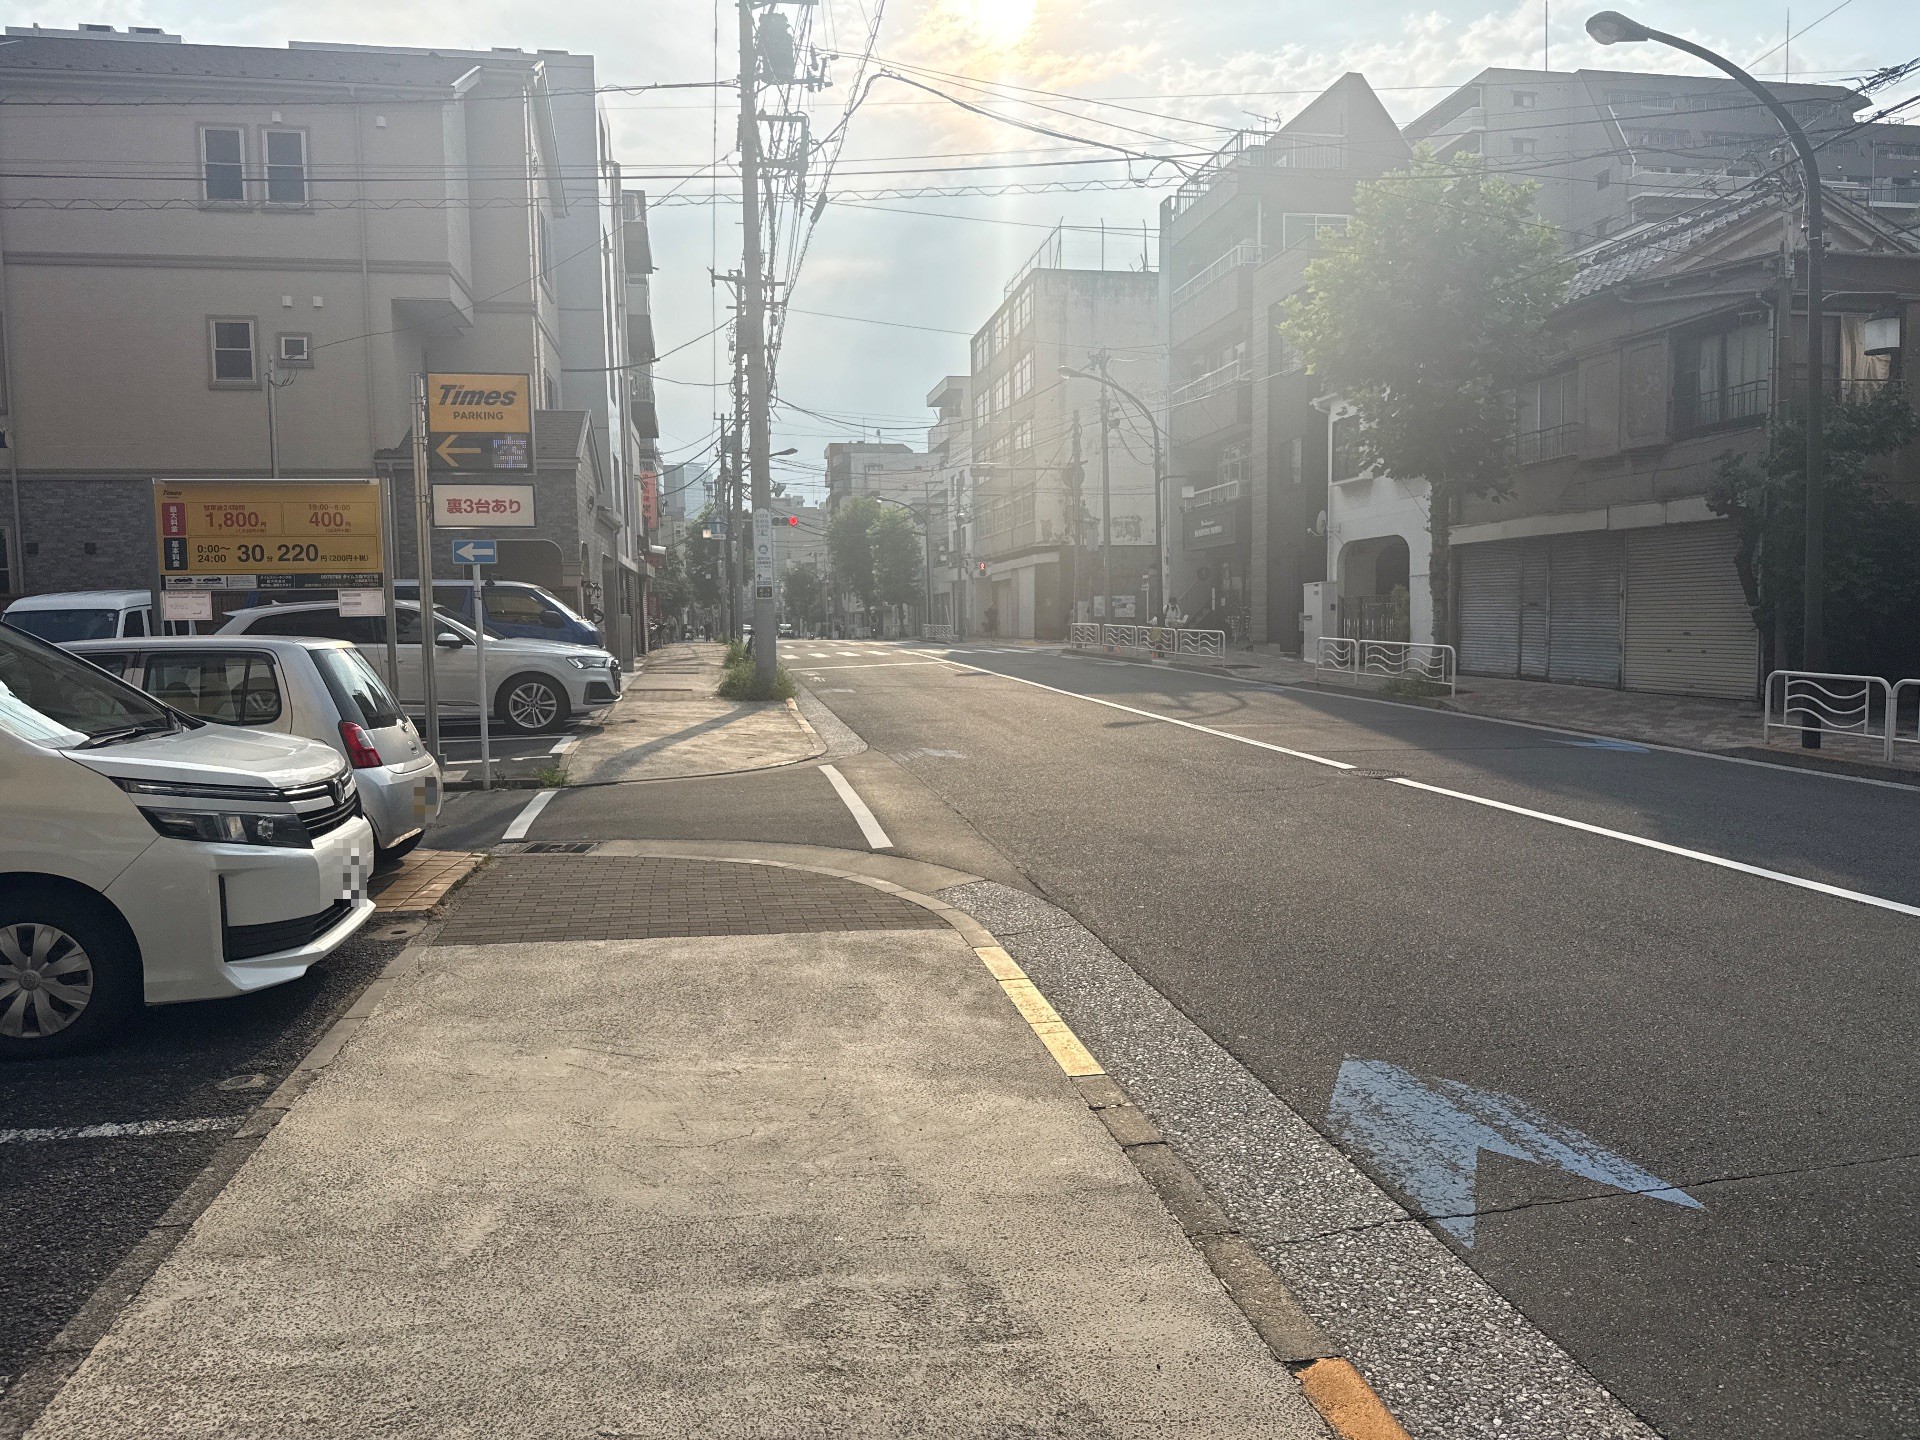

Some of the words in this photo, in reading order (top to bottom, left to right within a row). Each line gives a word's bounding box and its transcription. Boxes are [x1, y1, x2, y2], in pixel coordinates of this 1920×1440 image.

[438, 384, 517, 406] Times
[453, 411, 504, 420] PARKING
[446, 498, 522, 514] 裏3台あり
[197, 554, 227, 563] 24:00
